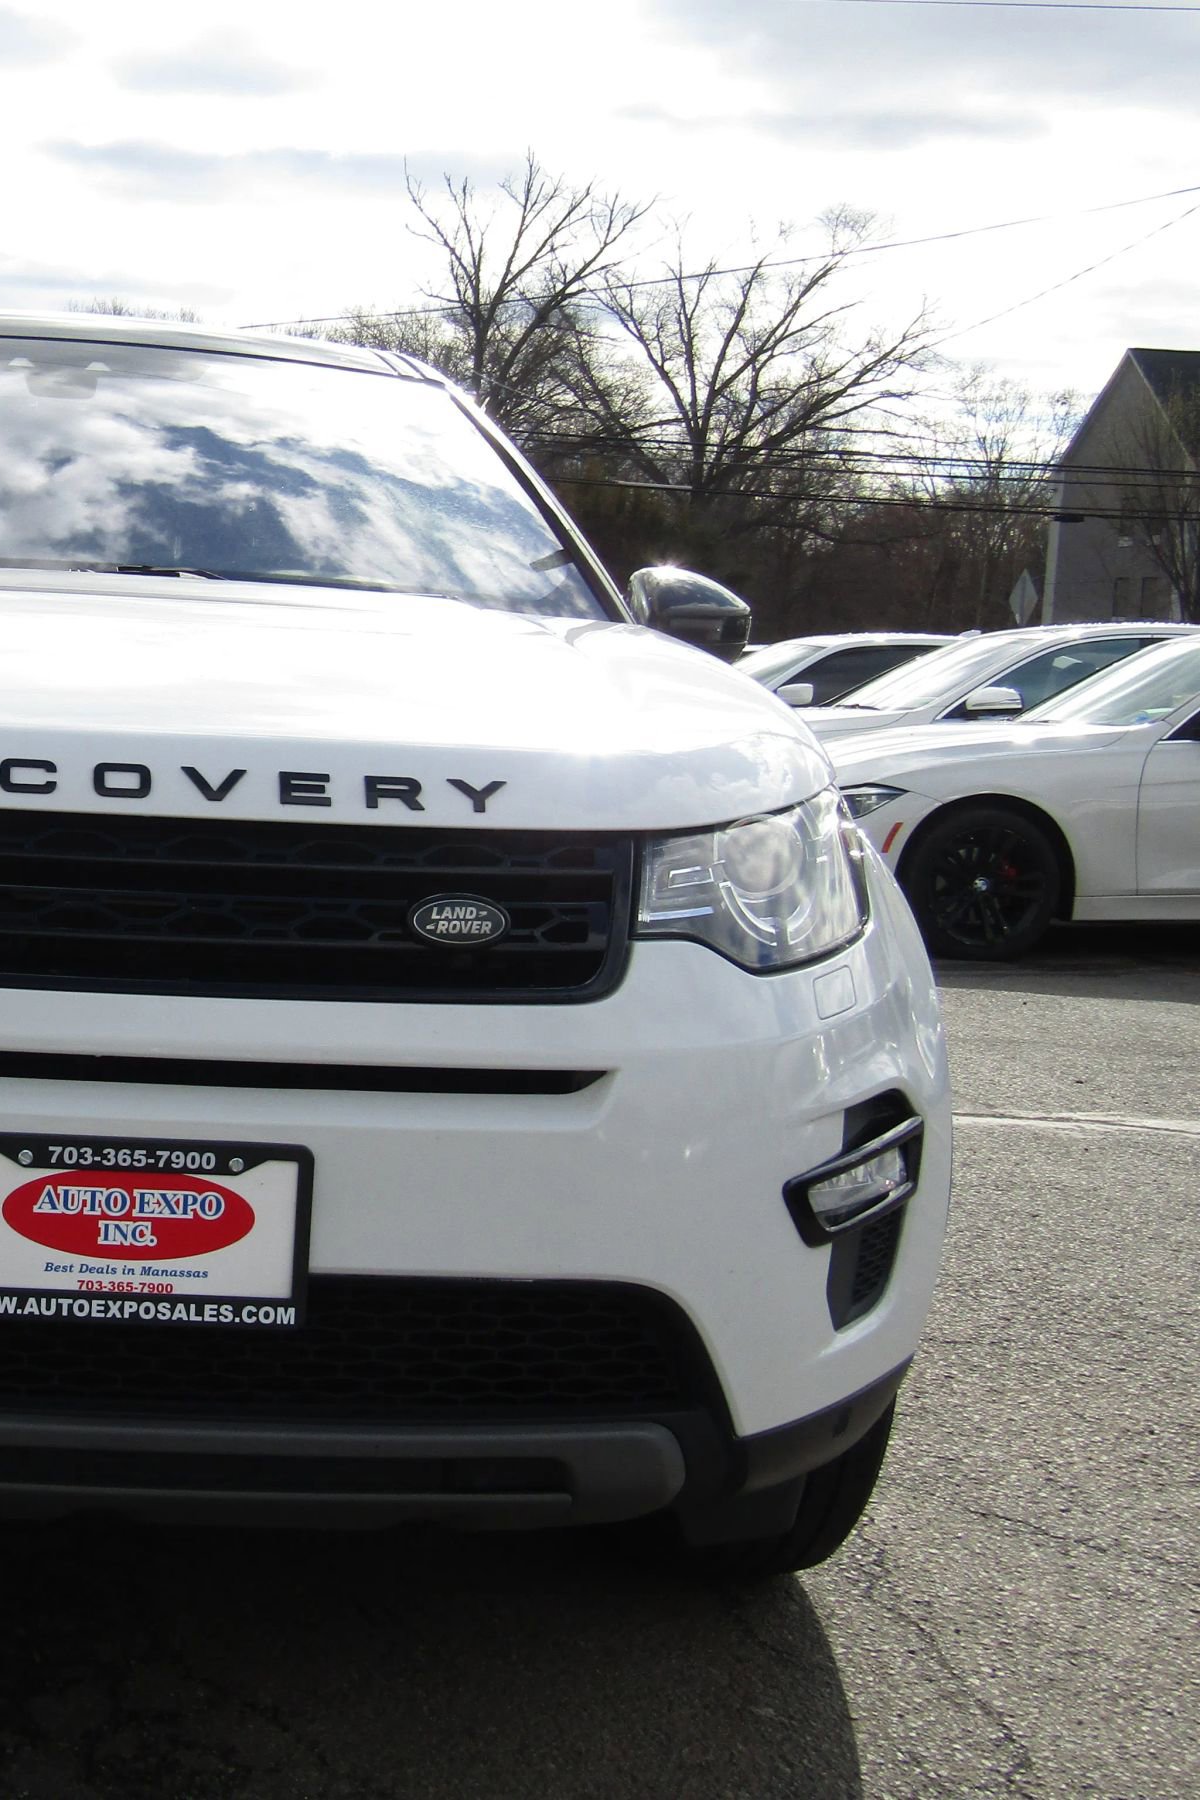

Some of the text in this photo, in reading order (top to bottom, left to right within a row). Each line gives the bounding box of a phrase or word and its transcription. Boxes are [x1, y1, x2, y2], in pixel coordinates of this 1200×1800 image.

[431, 906, 477, 920] LAND
[436, 920, 492, 934] ROVER
[48, 1146, 216, 1170] 703-365-7900
[34, 1185, 225, 1220] AUTO EXPO
[97, 1220, 158, 1246] INC.
[44, 1262, 209, 1279] Best Deals in Manassas
[77, 1279, 174, 1294] 703-365-7900
